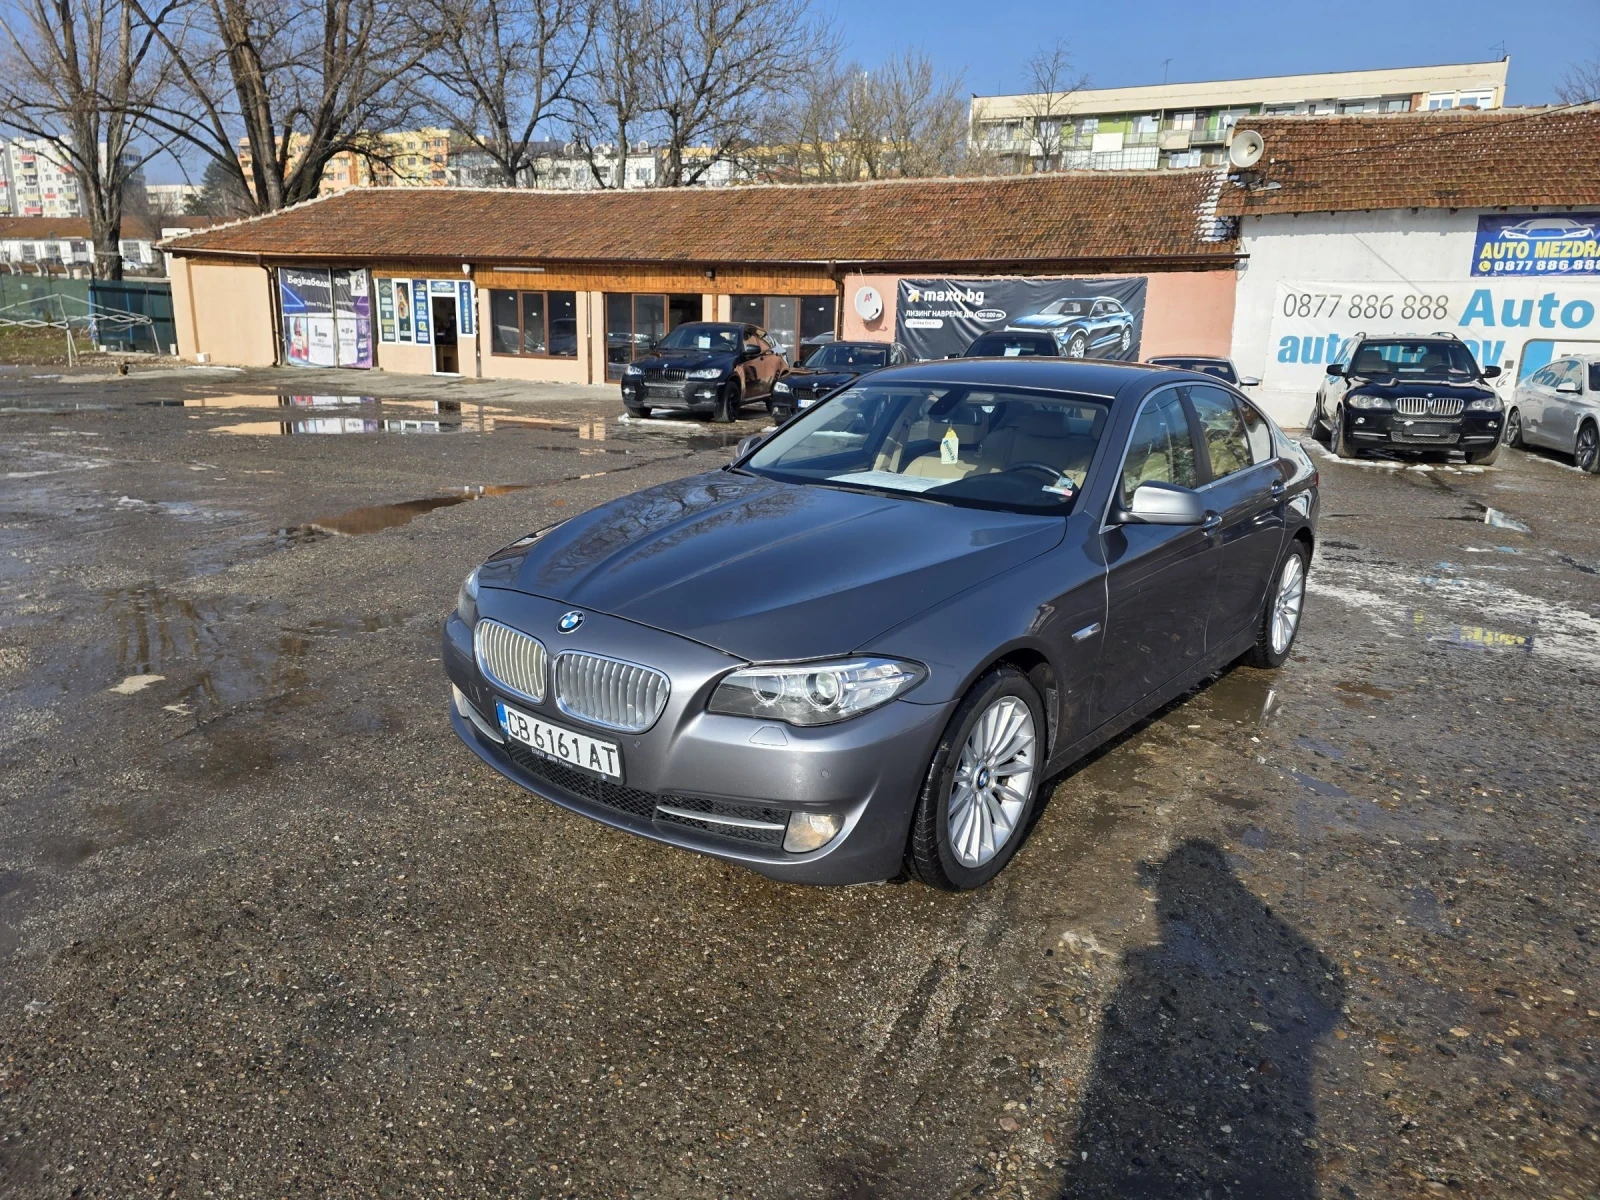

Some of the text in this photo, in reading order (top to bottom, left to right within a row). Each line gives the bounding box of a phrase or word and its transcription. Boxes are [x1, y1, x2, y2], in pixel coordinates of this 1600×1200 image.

[1480, 241, 1530, 259] AUTO
[1494, 260, 1533, 271] 0877
[1536, 260, 1569, 270] 886
[864, 292, 873, 302] A1
[924, 288, 985, 306] maxo.bg
[932, 310, 963, 318] НАВРЕМЕ
[964, 311, 974, 319] ДО
[1283, 289, 1595, 328] 0877 886 888 Auto
[508, 711, 531, 742] CB
[534, 724, 580, 763] 6161
[589, 743, 616, 773] AT
